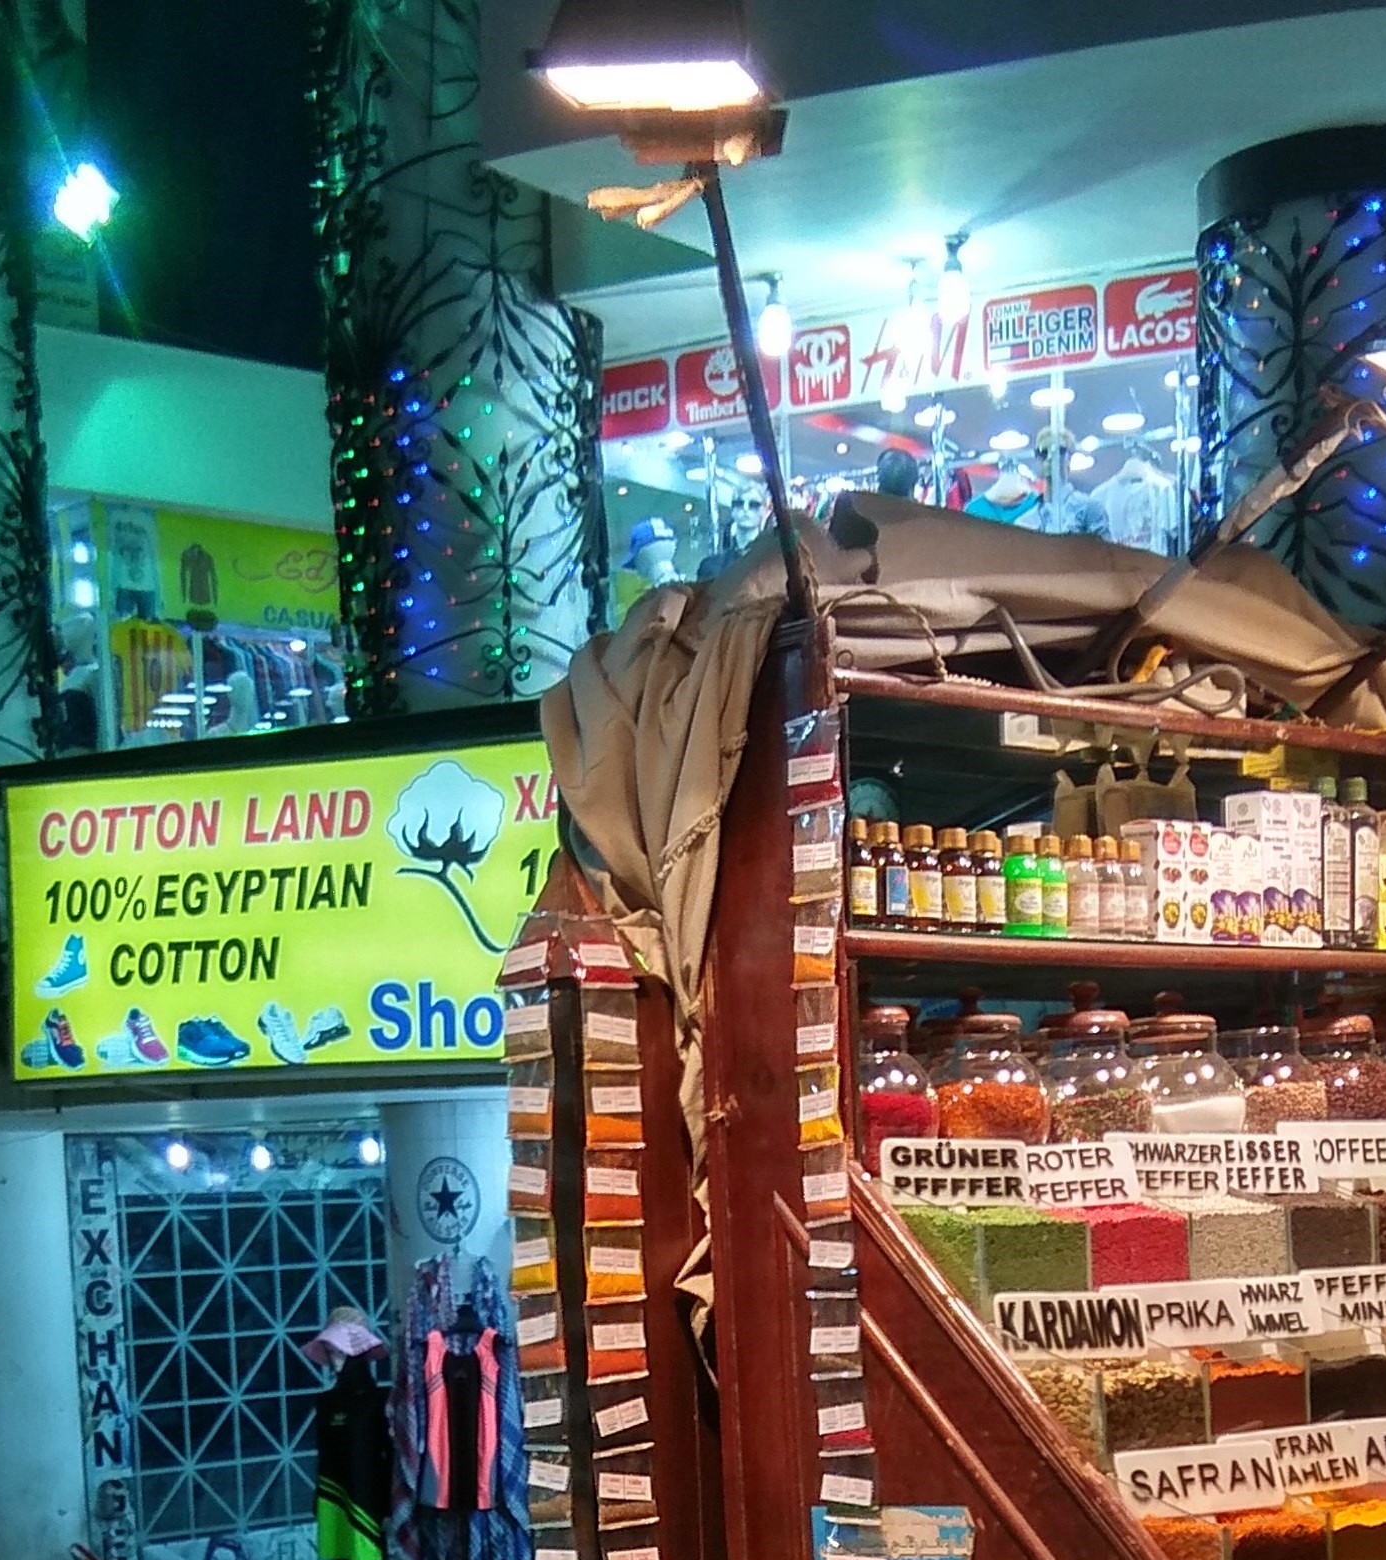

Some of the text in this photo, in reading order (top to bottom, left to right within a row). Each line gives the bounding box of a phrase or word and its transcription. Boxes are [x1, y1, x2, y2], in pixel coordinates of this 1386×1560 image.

[988, 306, 1094, 344] HILFIGER
[989, 303, 1030, 320] TOMMY
[1031, 330, 1094, 358] DENIM
[38, 788, 373, 859] COTTON LAND
[44, 861, 373, 925] 100% EGYPTIAN
[109, 936, 281, 987] COTTON
[890, 1141, 1019, 1169] GRÜNER
[1027, 1146, 1114, 1173] ROTER
[998, 1297, 1146, 1350] KARDAMON
[1146, 1300, 1235, 1332] PRIKA
[1275, 1431, 1334, 1459] FRAN
[1130, 1456, 1277, 1503] SAFRAN
